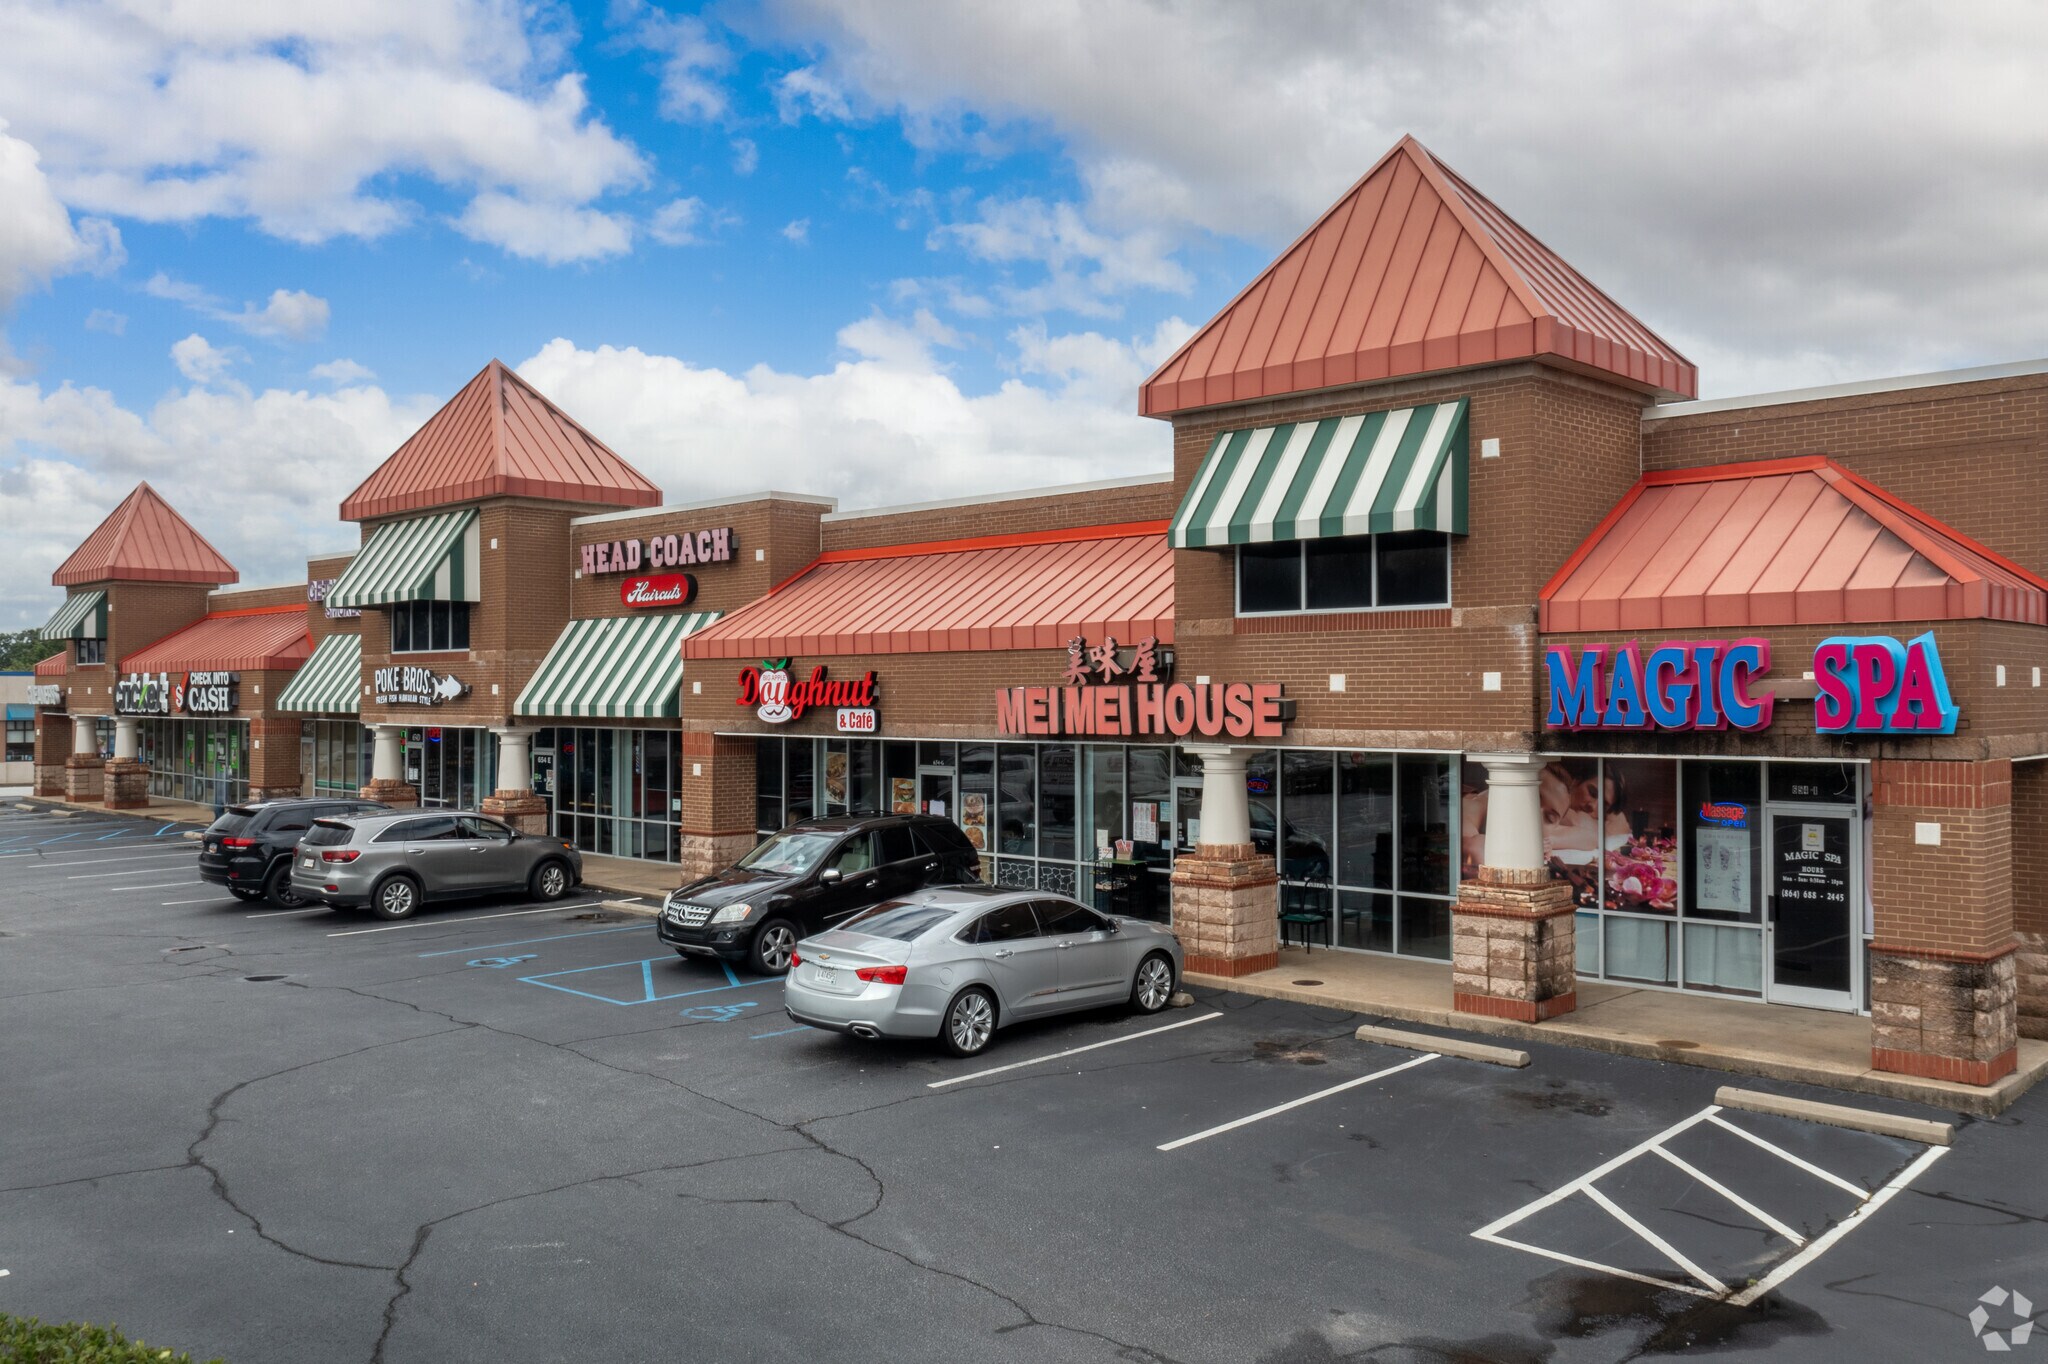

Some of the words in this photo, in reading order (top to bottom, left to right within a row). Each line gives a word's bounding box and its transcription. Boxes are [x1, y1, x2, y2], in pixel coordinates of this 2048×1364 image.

[580, 538, 642, 575] HEAD
[650, 527, 730, 568] COACH
[626, 580, 682, 604] Haircuts
[1061, 635, 1162, 686] 美味屋
[190, 671, 212, 685] CHECK
[213, 671, 230, 685] INTO
[375, 666, 400, 694] POKE
[403, 666, 432, 695] BROS.
[762, 673, 771, 682] BIG
[772, 673, 787, 682] APPLE
[1545, 642, 1769, 730] MAGIC
[1813, 637, 1950, 731] SPA
[114, 671, 170, 714] cricket
[736, 665, 874, 720] Doughnut
[839, 713, 847, 728] &
[849, 711, 873, 729] Café
[996, 686, 1060, 735] MEI
[1064, 685, 1133, 736] MEI
[1137, 682, 1284, 738] HOUSE
[1247, 780, 1270, 790] OPEN
[1702, 802, 1744, 821] Massage
[1784, 851, 1820, 862] MAGIC
[1824, 852, 1842, 865] SPA
[1801, 865, 1825, 874] HOURS
[1781, 888, 1801, 899] (864)
[1826, 892, 1845, 902] 2445
